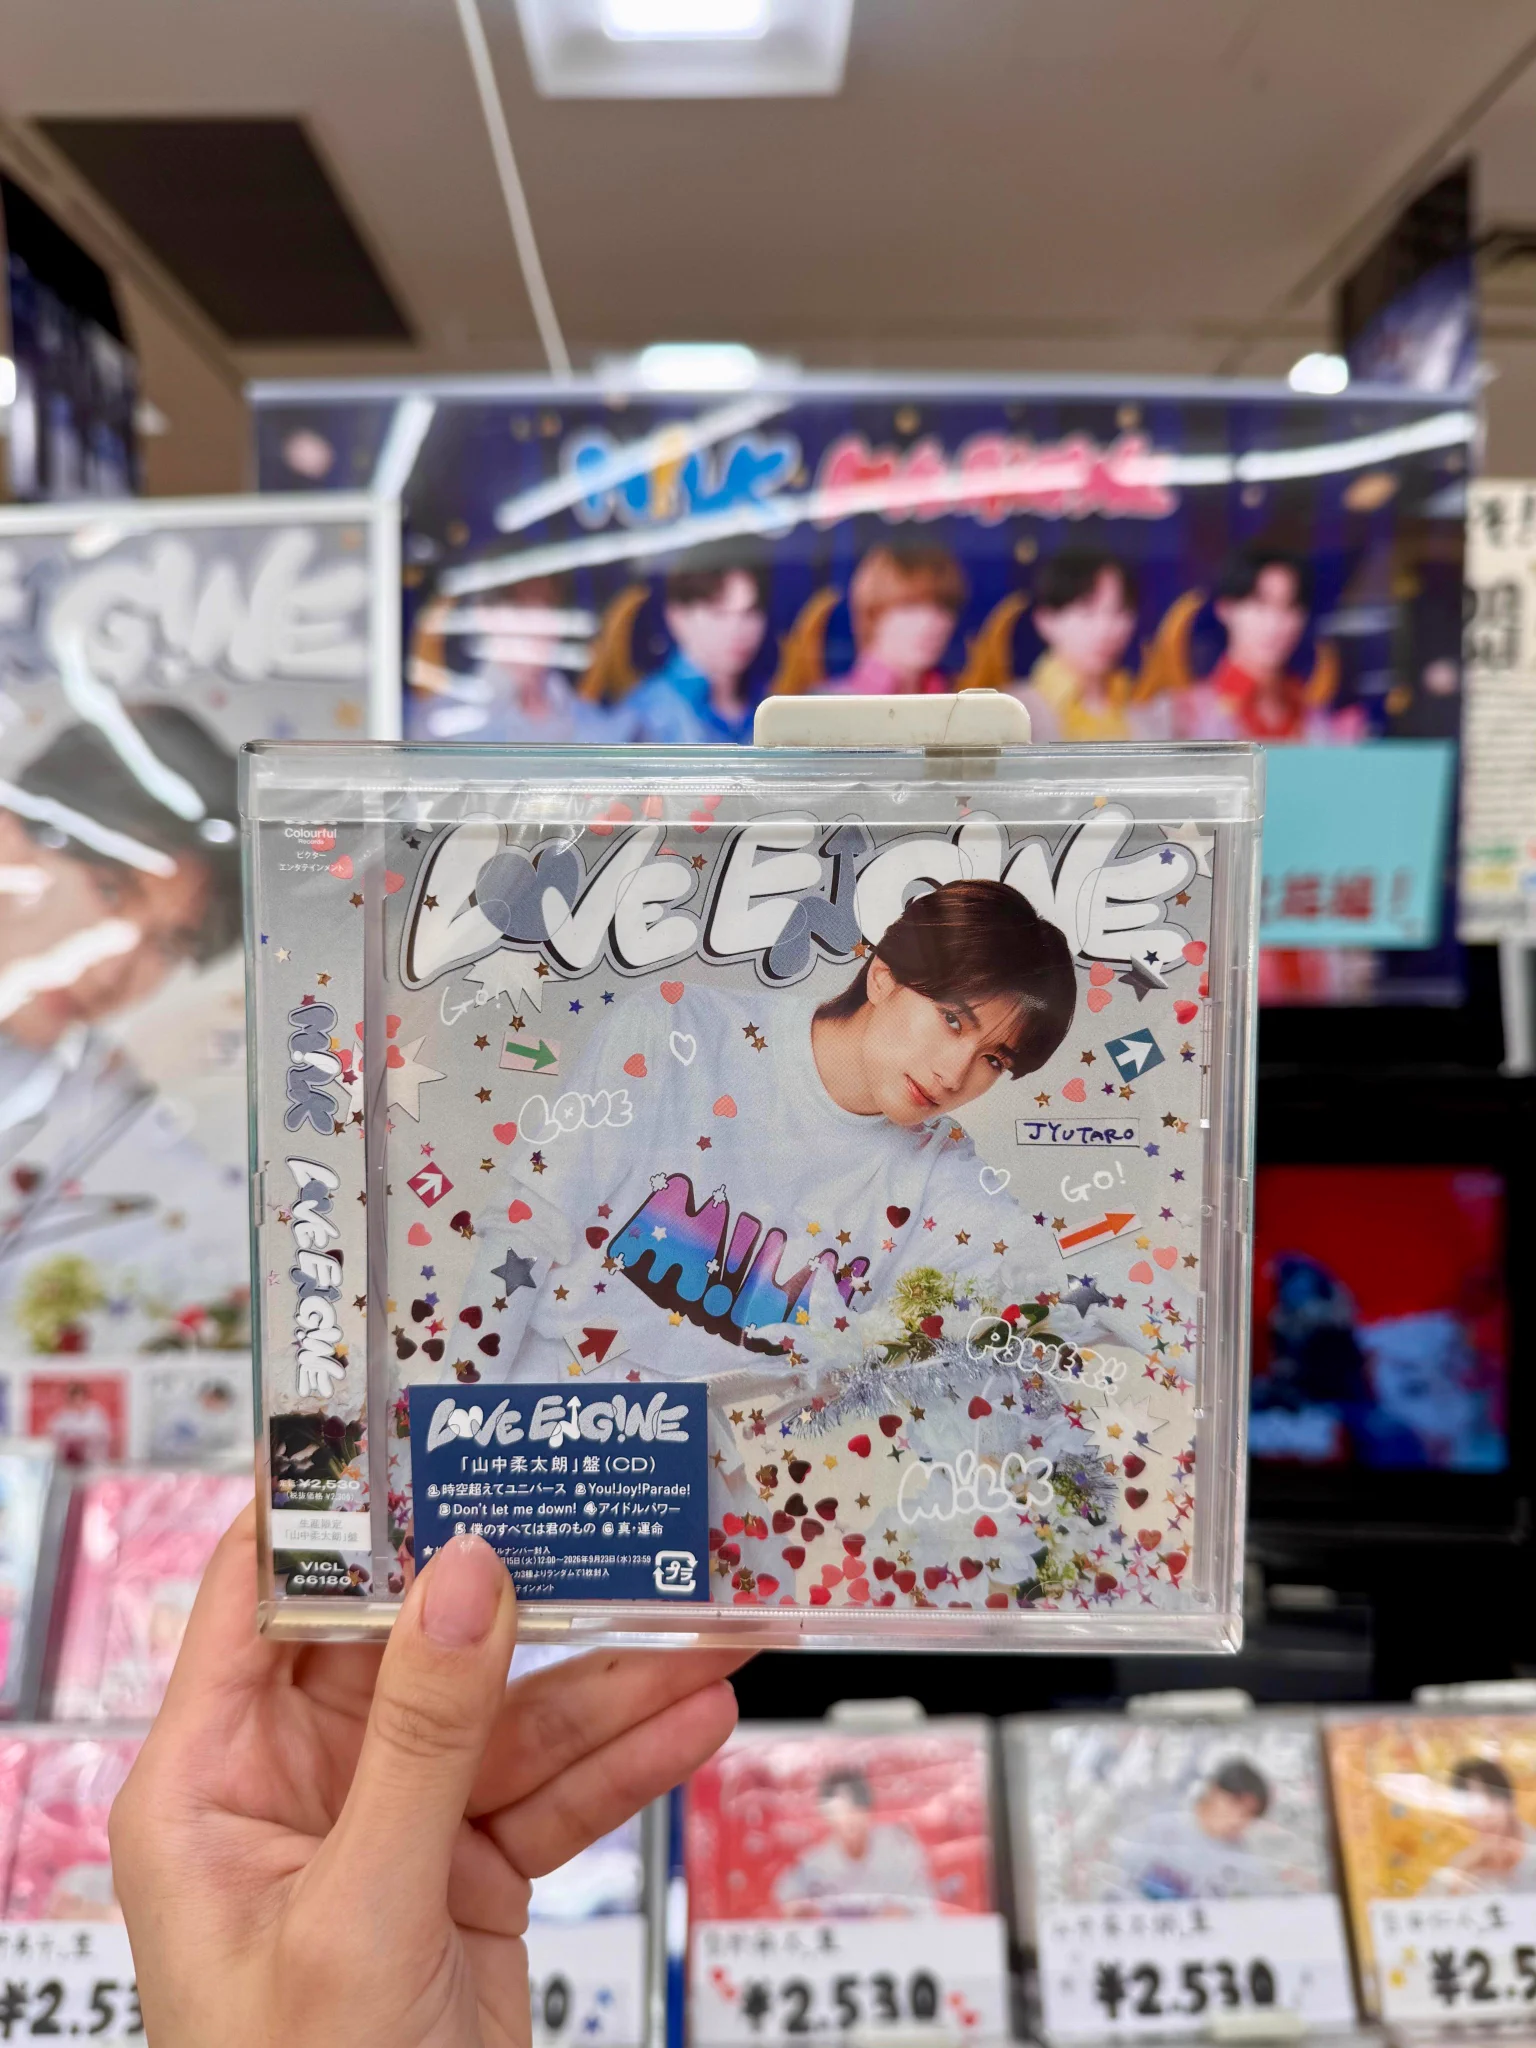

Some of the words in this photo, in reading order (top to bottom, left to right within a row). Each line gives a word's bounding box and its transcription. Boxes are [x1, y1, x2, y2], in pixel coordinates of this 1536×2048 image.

[284, 827, 337, 839] Colourful
[296, 850, 327, 859] ビクター
[279, 864, 345, 872] エンタテインメント
[518, 1089, 633, 1145] LOVE
[1024, 1122, 1135, 1143] JYUTARO
[492, 1504, 508, 1515] let
[513, 1506, 533, 1515] me
[538, 1503, 577, 1515] down!
[300, 1562, 344, 1572] VICL
[293, 1575, 352, 1585] 66180
